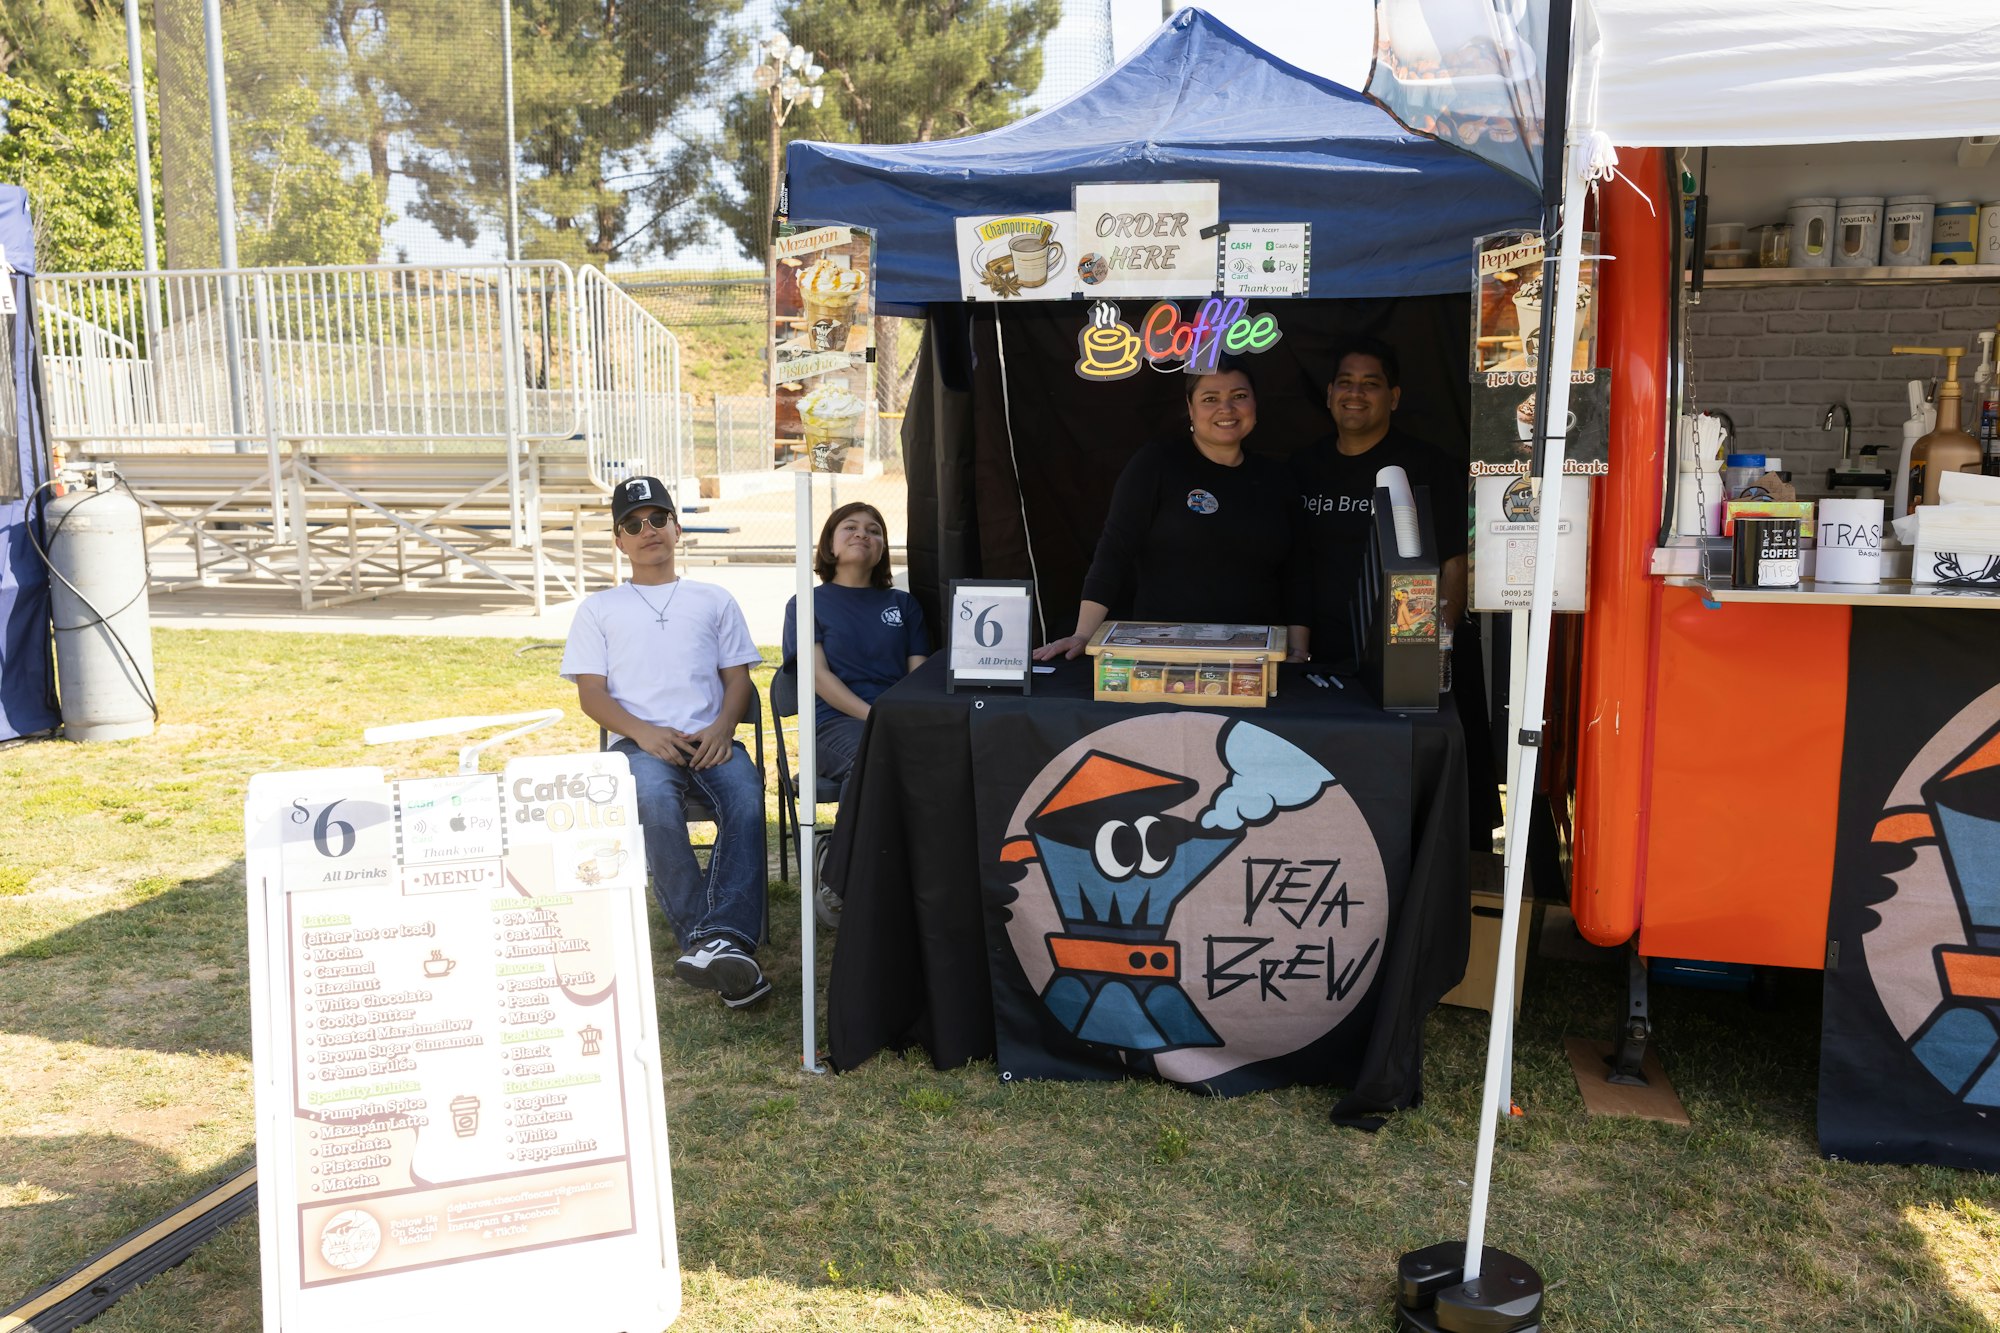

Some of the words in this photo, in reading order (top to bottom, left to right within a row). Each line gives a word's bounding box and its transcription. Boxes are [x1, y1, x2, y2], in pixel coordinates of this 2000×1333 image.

[1095, 212, 1189, 239] ORDER
[1230, 242, 1252, 250] CASH
[1108, 245, 1181, 271] HERE
[1279, 260, 1298, 274] Pay
[1239, 284, 1269, 293] Thank
[1270, 286, 1289, 295] you
[1144, 297, 1278, 369] Coffee
[1487, 372, 1515, 387] Hot
[1518, 371, 1595, 387] Chate
[1338, 495, 1375, 512] Bre
[1761, 549, 1797, 558] COFFEE
[978, 657, 991, 665] All
[993, 657, 1023, 666] Drinks
[512, 772, 586, 803] Café
[470, 816, 493, 831] Pay
[515, 804, 545, 824] de
[545, 801, 626, 833] Olla
[423, 847, 460, 859] Thank
[464, 846, 485, 857] you
[322, 871, 342, 882] All
[344, 868, 388, 880] Drinks
[423, 868, 486, 887] MENU
[1242, 856, 1365, 929] DEJA
[503, 912, 525, 926] 2%
[527, 910, 559, 924] Milk
[302, 931, 350, 949] (either
[353, 927, 379, 941] hot
[381, 928, 398, 939] or
[504, 928, 530, 942] Oat
[531, 926, 563, 940] Milk
[313, 947, 363, 962] Mocha
[505, 943, 558, 959] Almond
[559, 938, 591, 952] Milk
[314, 962, 375, 978] Caramel
[1202, 934, 1380, 1002] BREW
[315, 978, 381, 996] Hazelnut
[507, 976, 559, 992] Passion
[561, 971, 596, 986] Fruit
[316, 998, 359, 1012] White
[361, 989, 432, 1008] Chocolate
[508, 993, 550, 1008] Peach
[316, 1012, 367, 1029] Cookie
[368, 1008, 416, 1024] Butter
[509, 1009, 556, 1025] Mango
[317, 1029, 376, 1047] Toasted
[378, 1018, 473, 1039] Marshmallow
[318, 1049, 367, 1064] Brown
[369, 1043, 411, 1060] Sugar
[412, 1034, 484, 1052] Cinnamon
[511, 1044, 552, 1061] Black
[318, 1065, 367, 1081] Crème
[512, 1062, 555, 1077] Green
[320, 1101, 385, 1122] Pumpkin
[386, 1097, 427, 1115] Spice
[514, 1093, 567, 1111] Regular
[515, 1109, 573, 1127] Mexican
[320, 1119, 387, 1140] Mazapán
[389, 1114, 429, 1130] Latte
[516, 1127, 558, 1144] White
[320, 1136, 392, 1158] Horchata
[517, 1138, 598, 1162] Peppermint
[321, 1154, 392, 1175] Pistachio
[322, 1174, 380, 1193] Matcha
[389, 1217, 422, 1229] Follow
[425, 1214, 439, 1224] Us
[513, 1206, 561, 1222] Facebook
[391, 1227, 406, 1238] On
[408, 1222, 438, 1235] Social
[494, 1223, 529, 1238] TikTok
